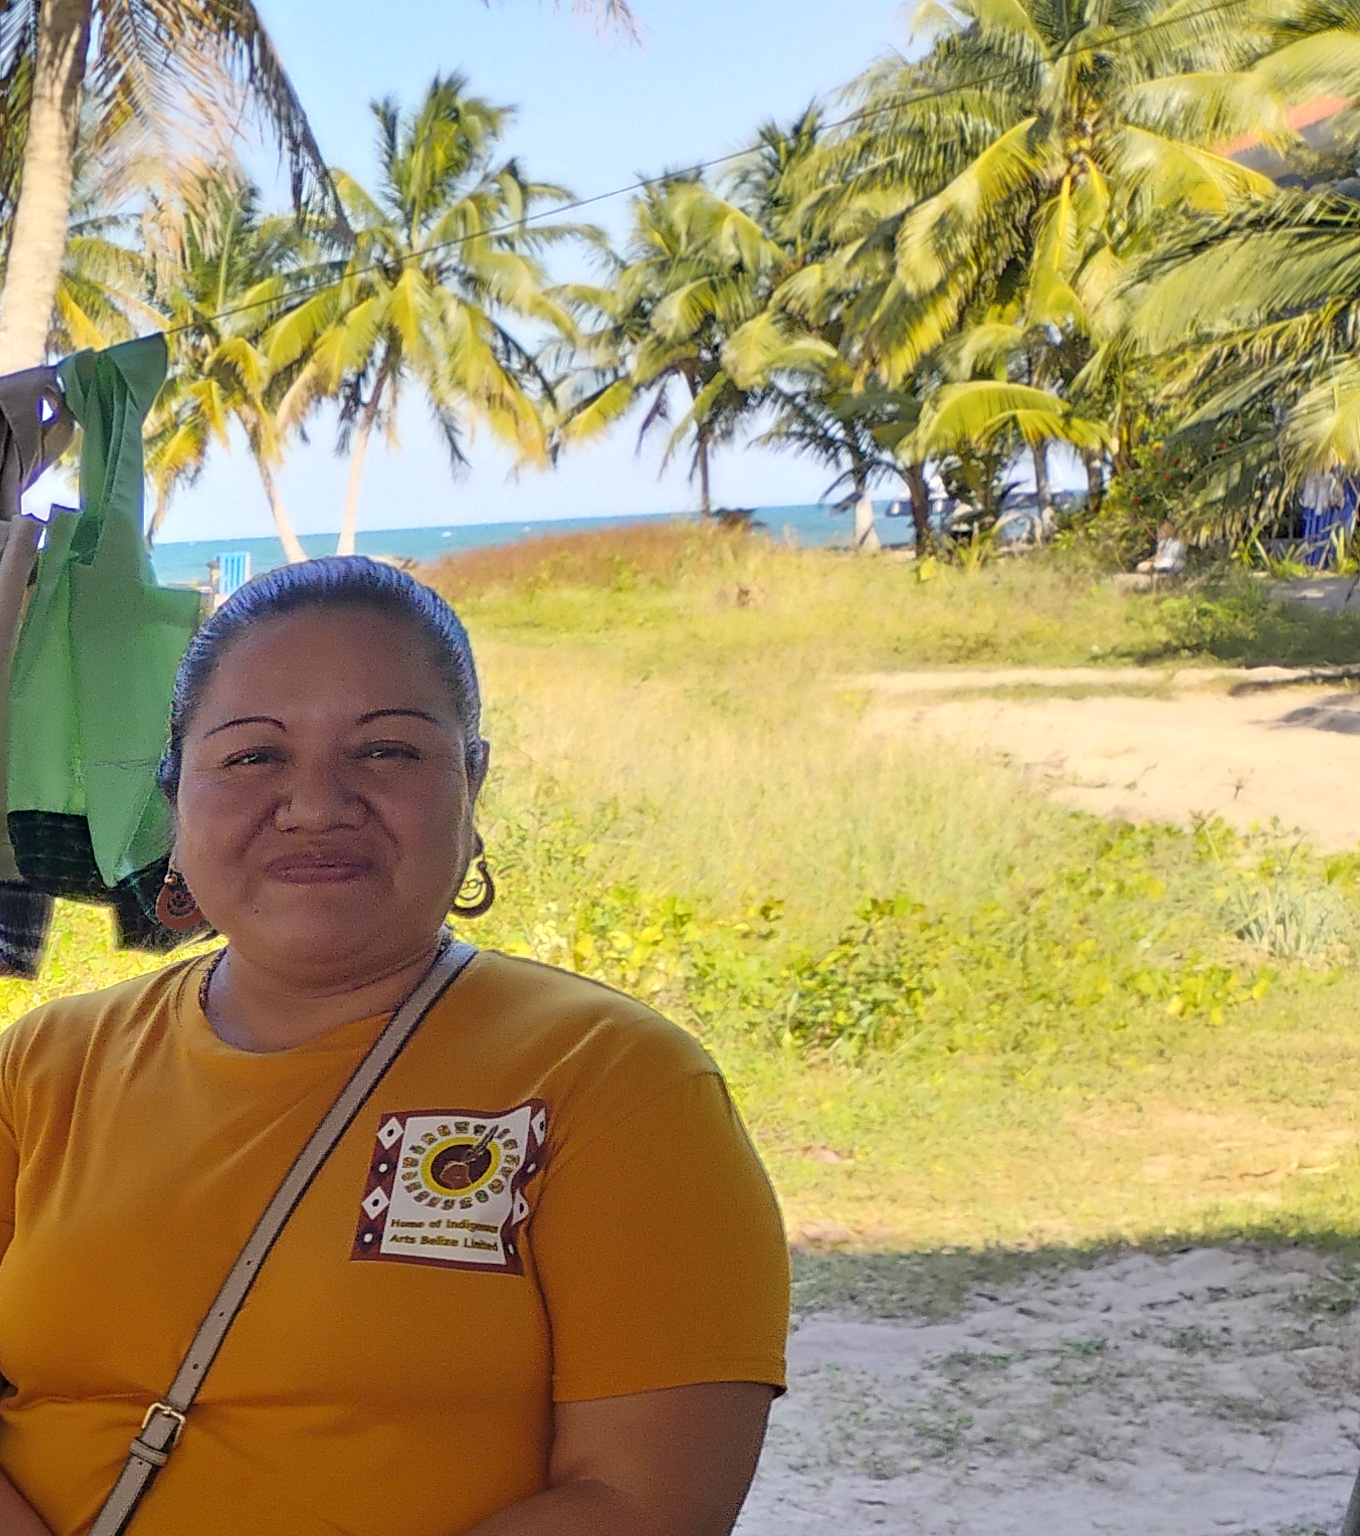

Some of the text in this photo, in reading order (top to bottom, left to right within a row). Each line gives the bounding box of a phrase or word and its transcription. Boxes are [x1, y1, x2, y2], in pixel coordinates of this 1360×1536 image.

[391, 1219, 424, 1229] Home
[429, 1219, 442, 1229] of
[389, 1235, 499, 1252] Arts Belize Limited
